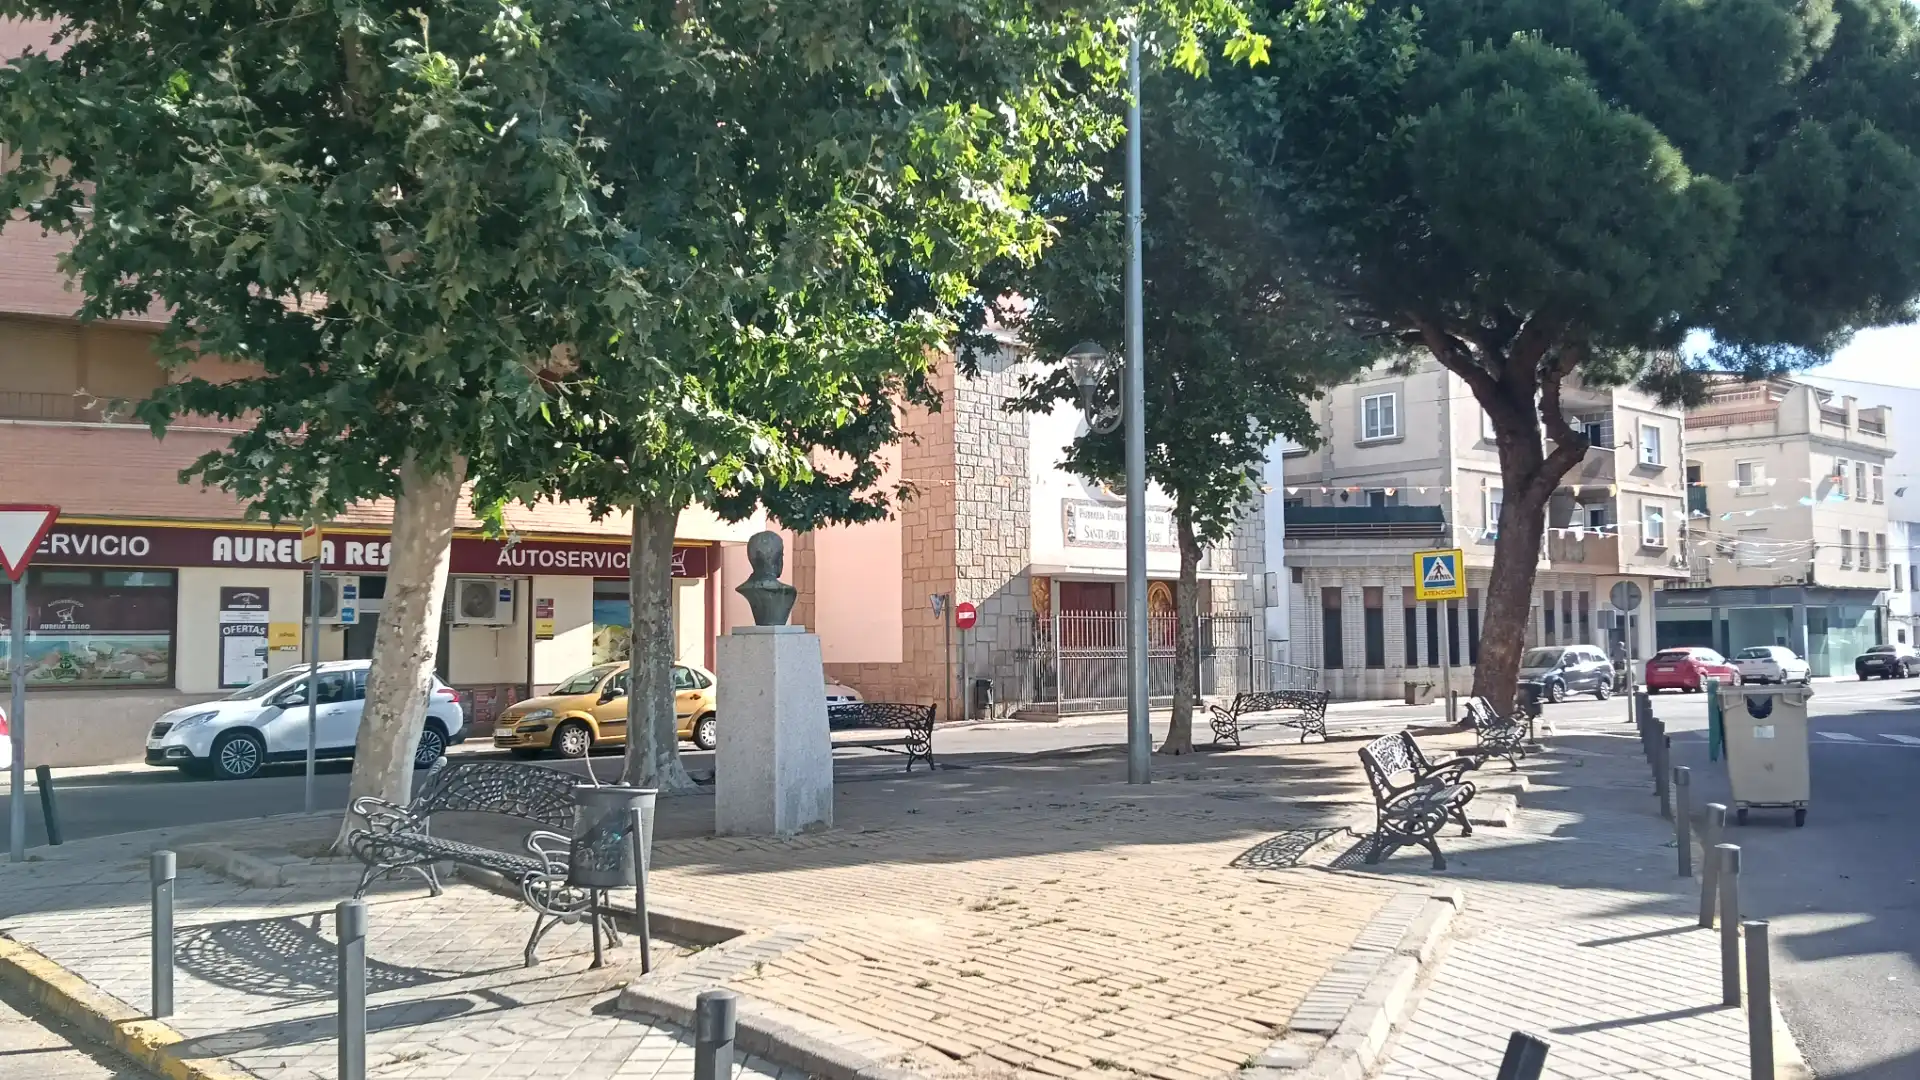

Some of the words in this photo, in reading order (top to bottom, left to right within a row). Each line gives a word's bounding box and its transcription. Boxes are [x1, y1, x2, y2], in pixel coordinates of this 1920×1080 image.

[212, 535, 336, 565] AURELA
[496, 548, 632, 569] AUTOSERVICI
[222, 624, 266, 635] OFERTAS
